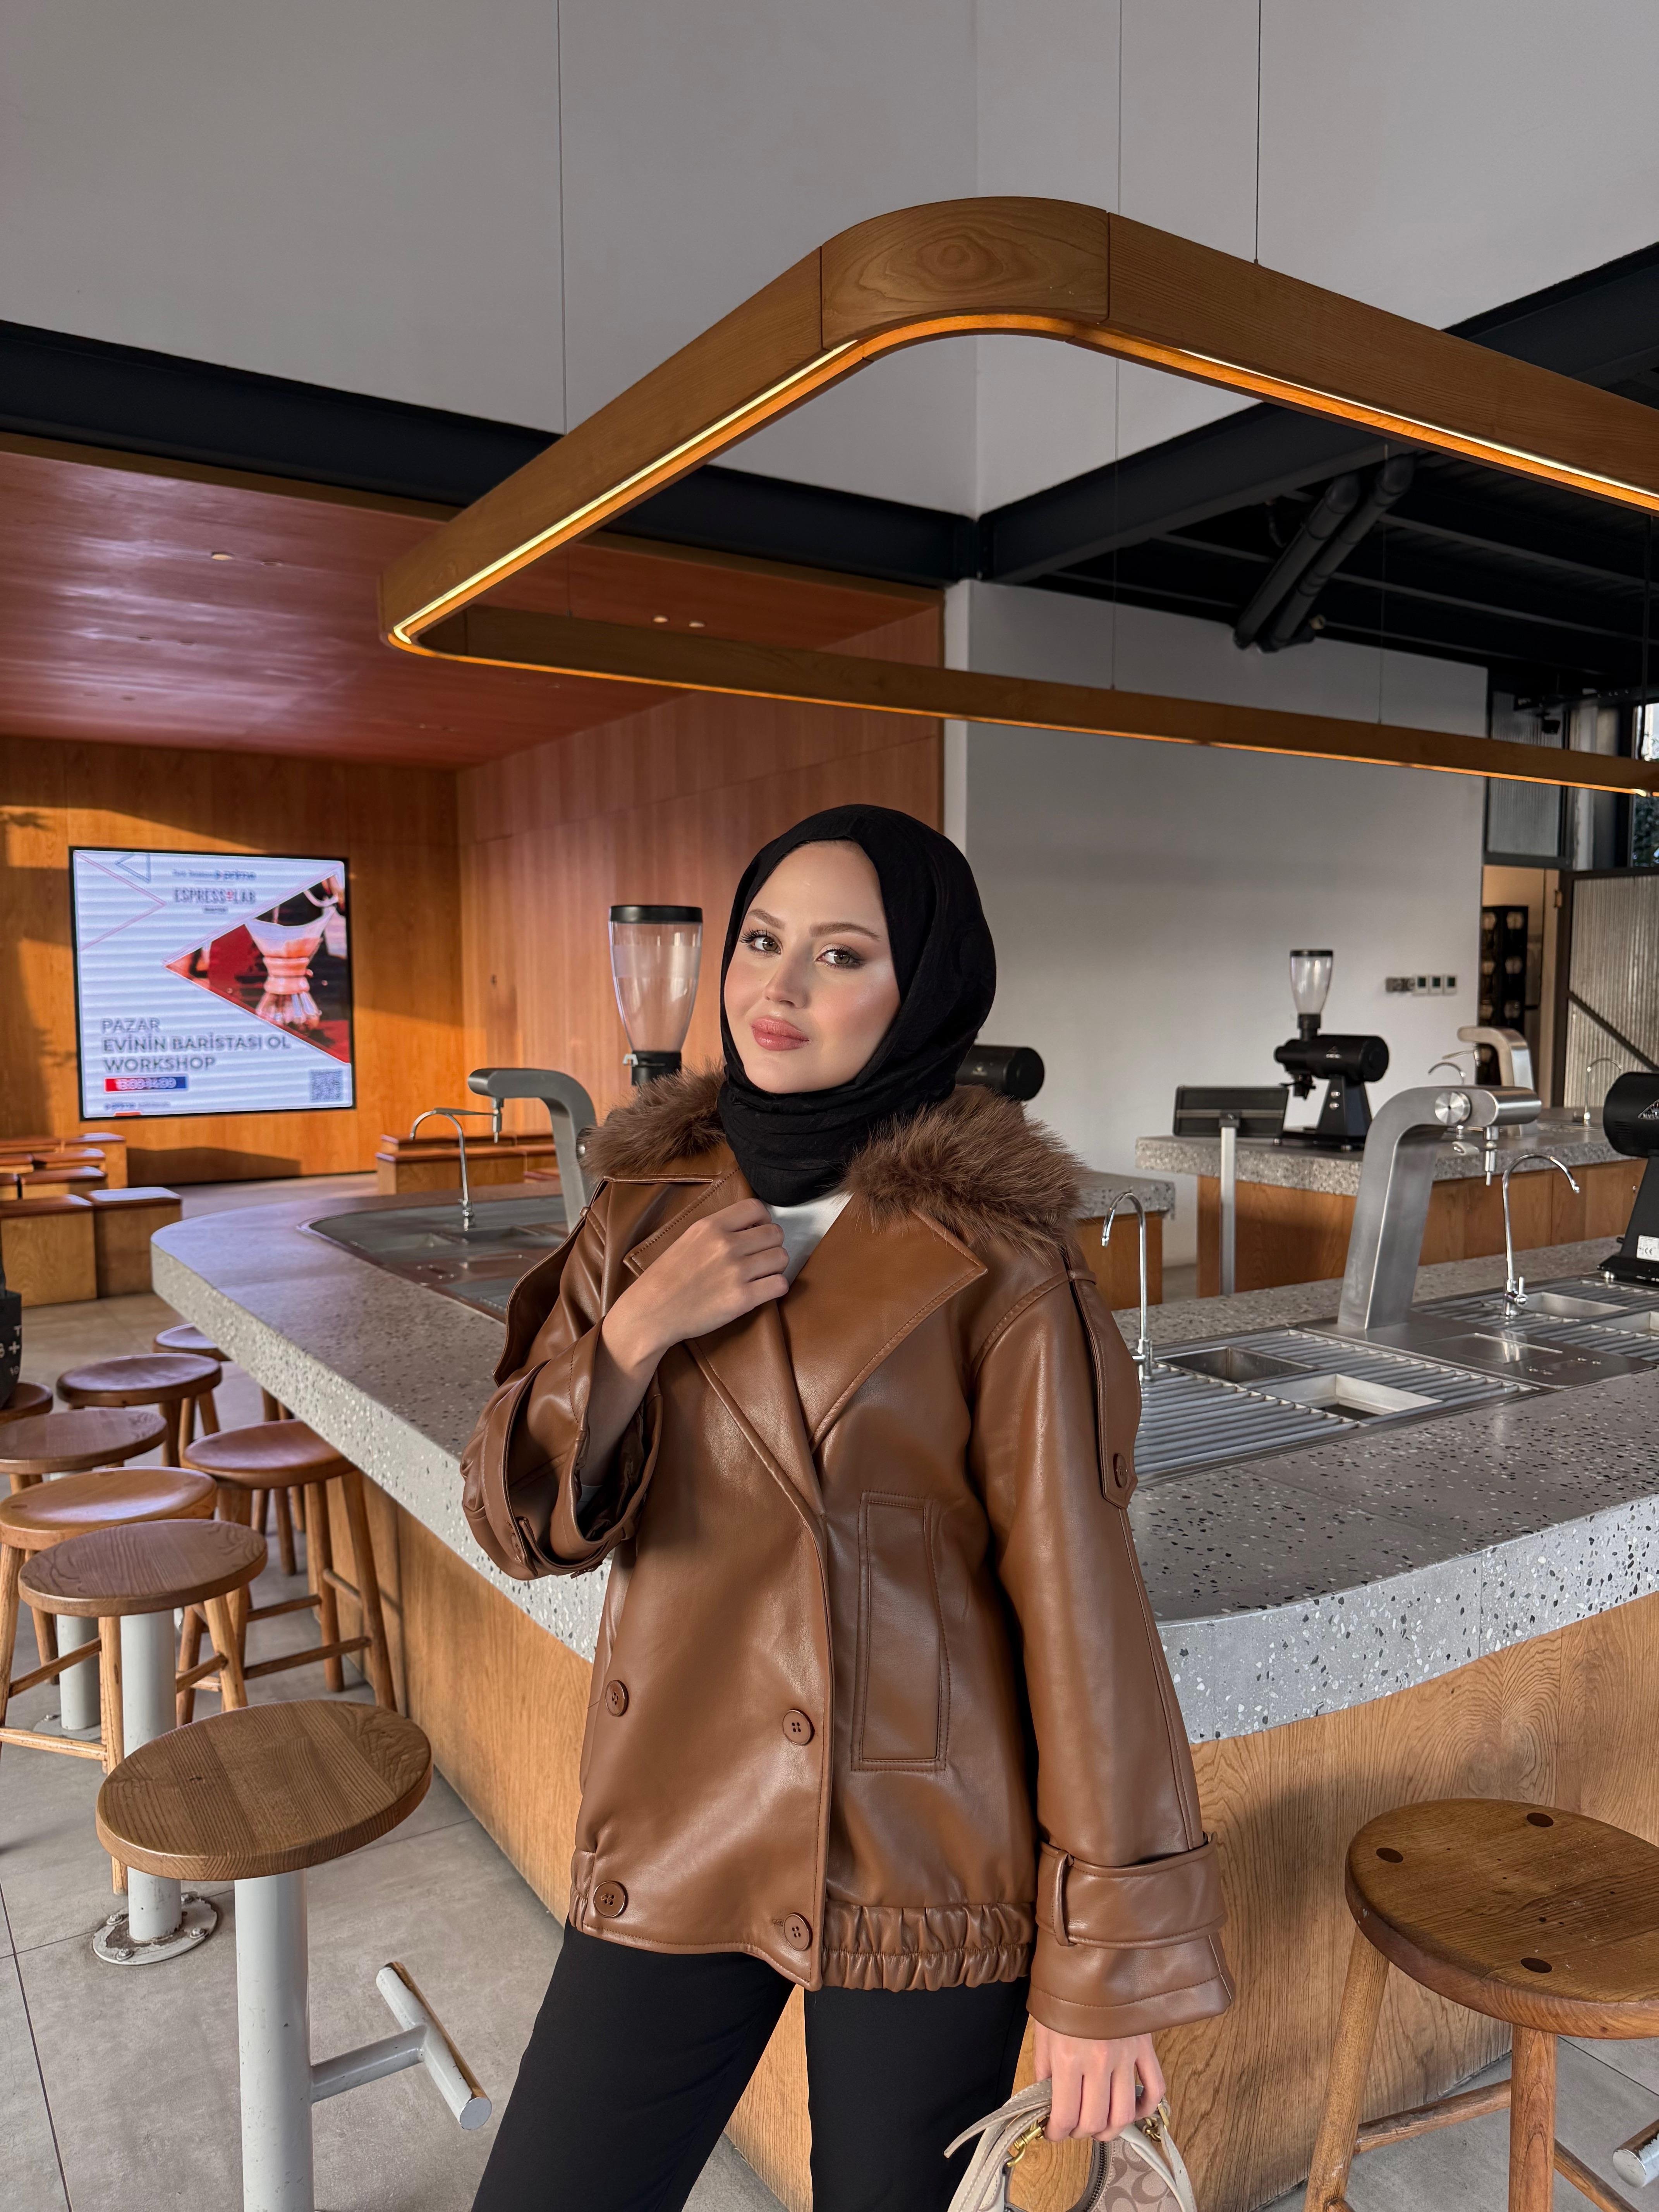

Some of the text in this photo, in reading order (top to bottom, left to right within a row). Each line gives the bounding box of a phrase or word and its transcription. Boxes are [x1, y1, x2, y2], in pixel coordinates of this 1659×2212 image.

[102, 1019, 160, 1032] PAZAR
[103, 1033, 291, 1052] EVİNİN BARİSTASI OL
[105, 1056, 215, 1072] WORKSHOP
